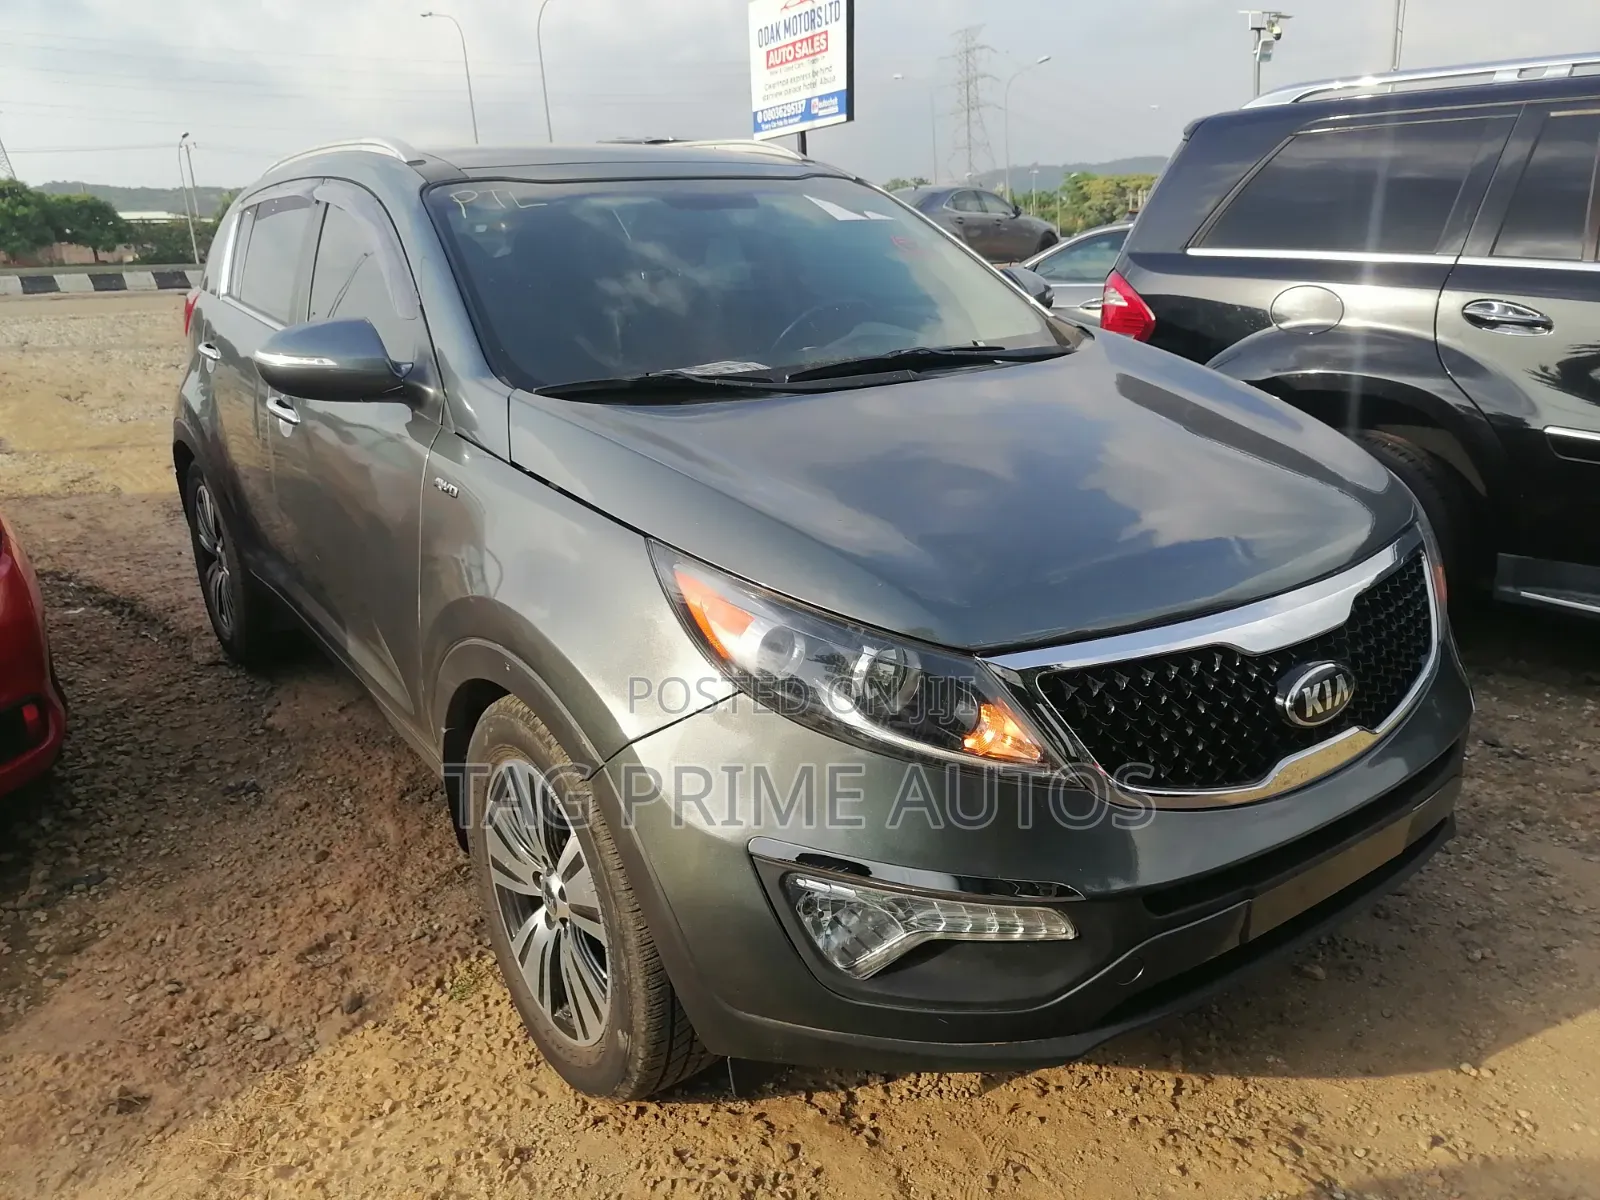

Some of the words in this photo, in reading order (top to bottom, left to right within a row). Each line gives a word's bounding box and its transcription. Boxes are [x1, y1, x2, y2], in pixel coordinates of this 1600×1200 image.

[757, 20, 781, 48] ODAK
[783, 6, 823, 39] MOTORS
[824, 0, 841, 26] LTD
[768, 43, 795, 67] AUTO
[794, 34, 827, 60] SALES
[1302, 673, 1349, 718] KIA
